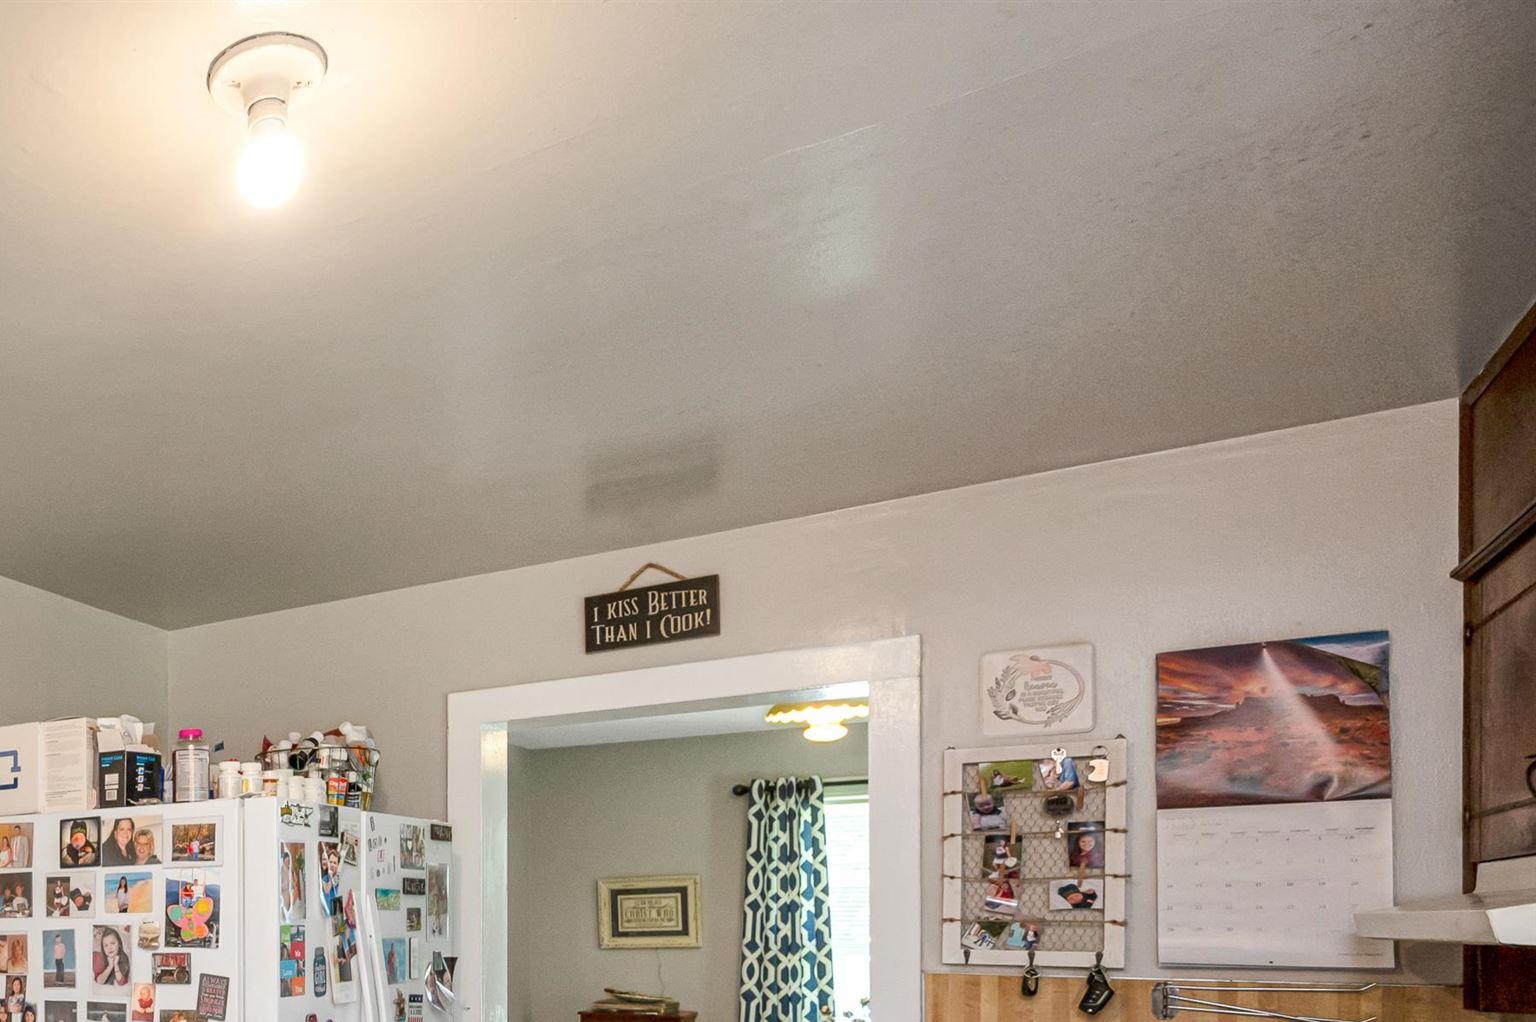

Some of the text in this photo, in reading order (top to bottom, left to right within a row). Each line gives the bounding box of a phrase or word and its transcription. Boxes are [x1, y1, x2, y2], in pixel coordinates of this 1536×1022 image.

[592, 589, 708, 622] I KISS BETTER
[591, 608, 712, 645] THAN I COOK!
